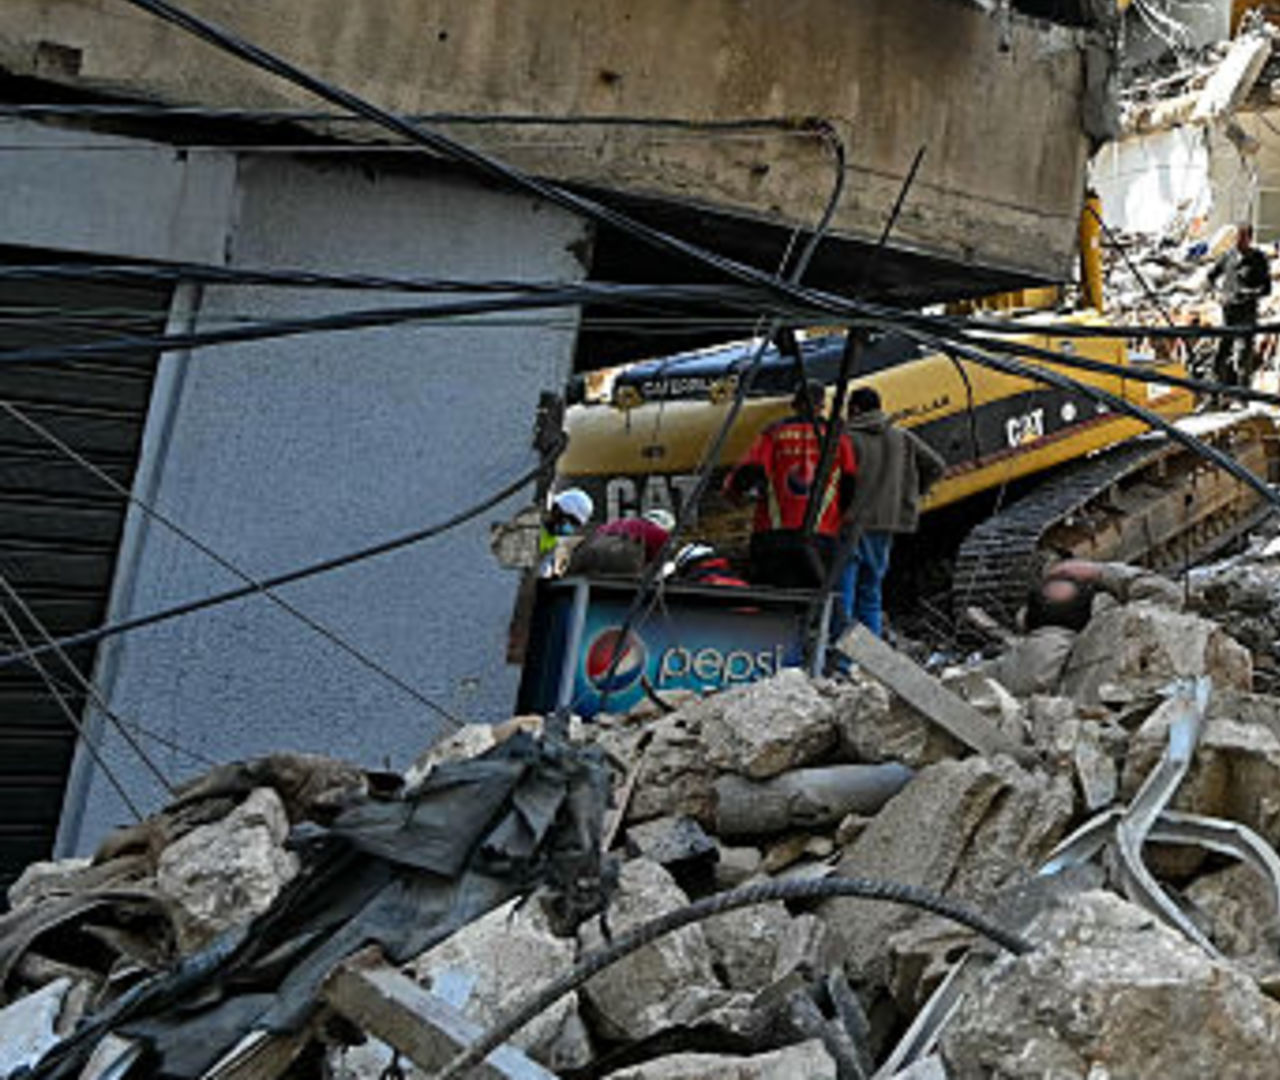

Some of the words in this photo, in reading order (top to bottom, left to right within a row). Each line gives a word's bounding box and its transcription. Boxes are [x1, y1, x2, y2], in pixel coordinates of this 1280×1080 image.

[1006, 408, 1043, 447] CAT
[606, 475, 703, 526] CAT
[659, 645, 783, 686] pepsi
